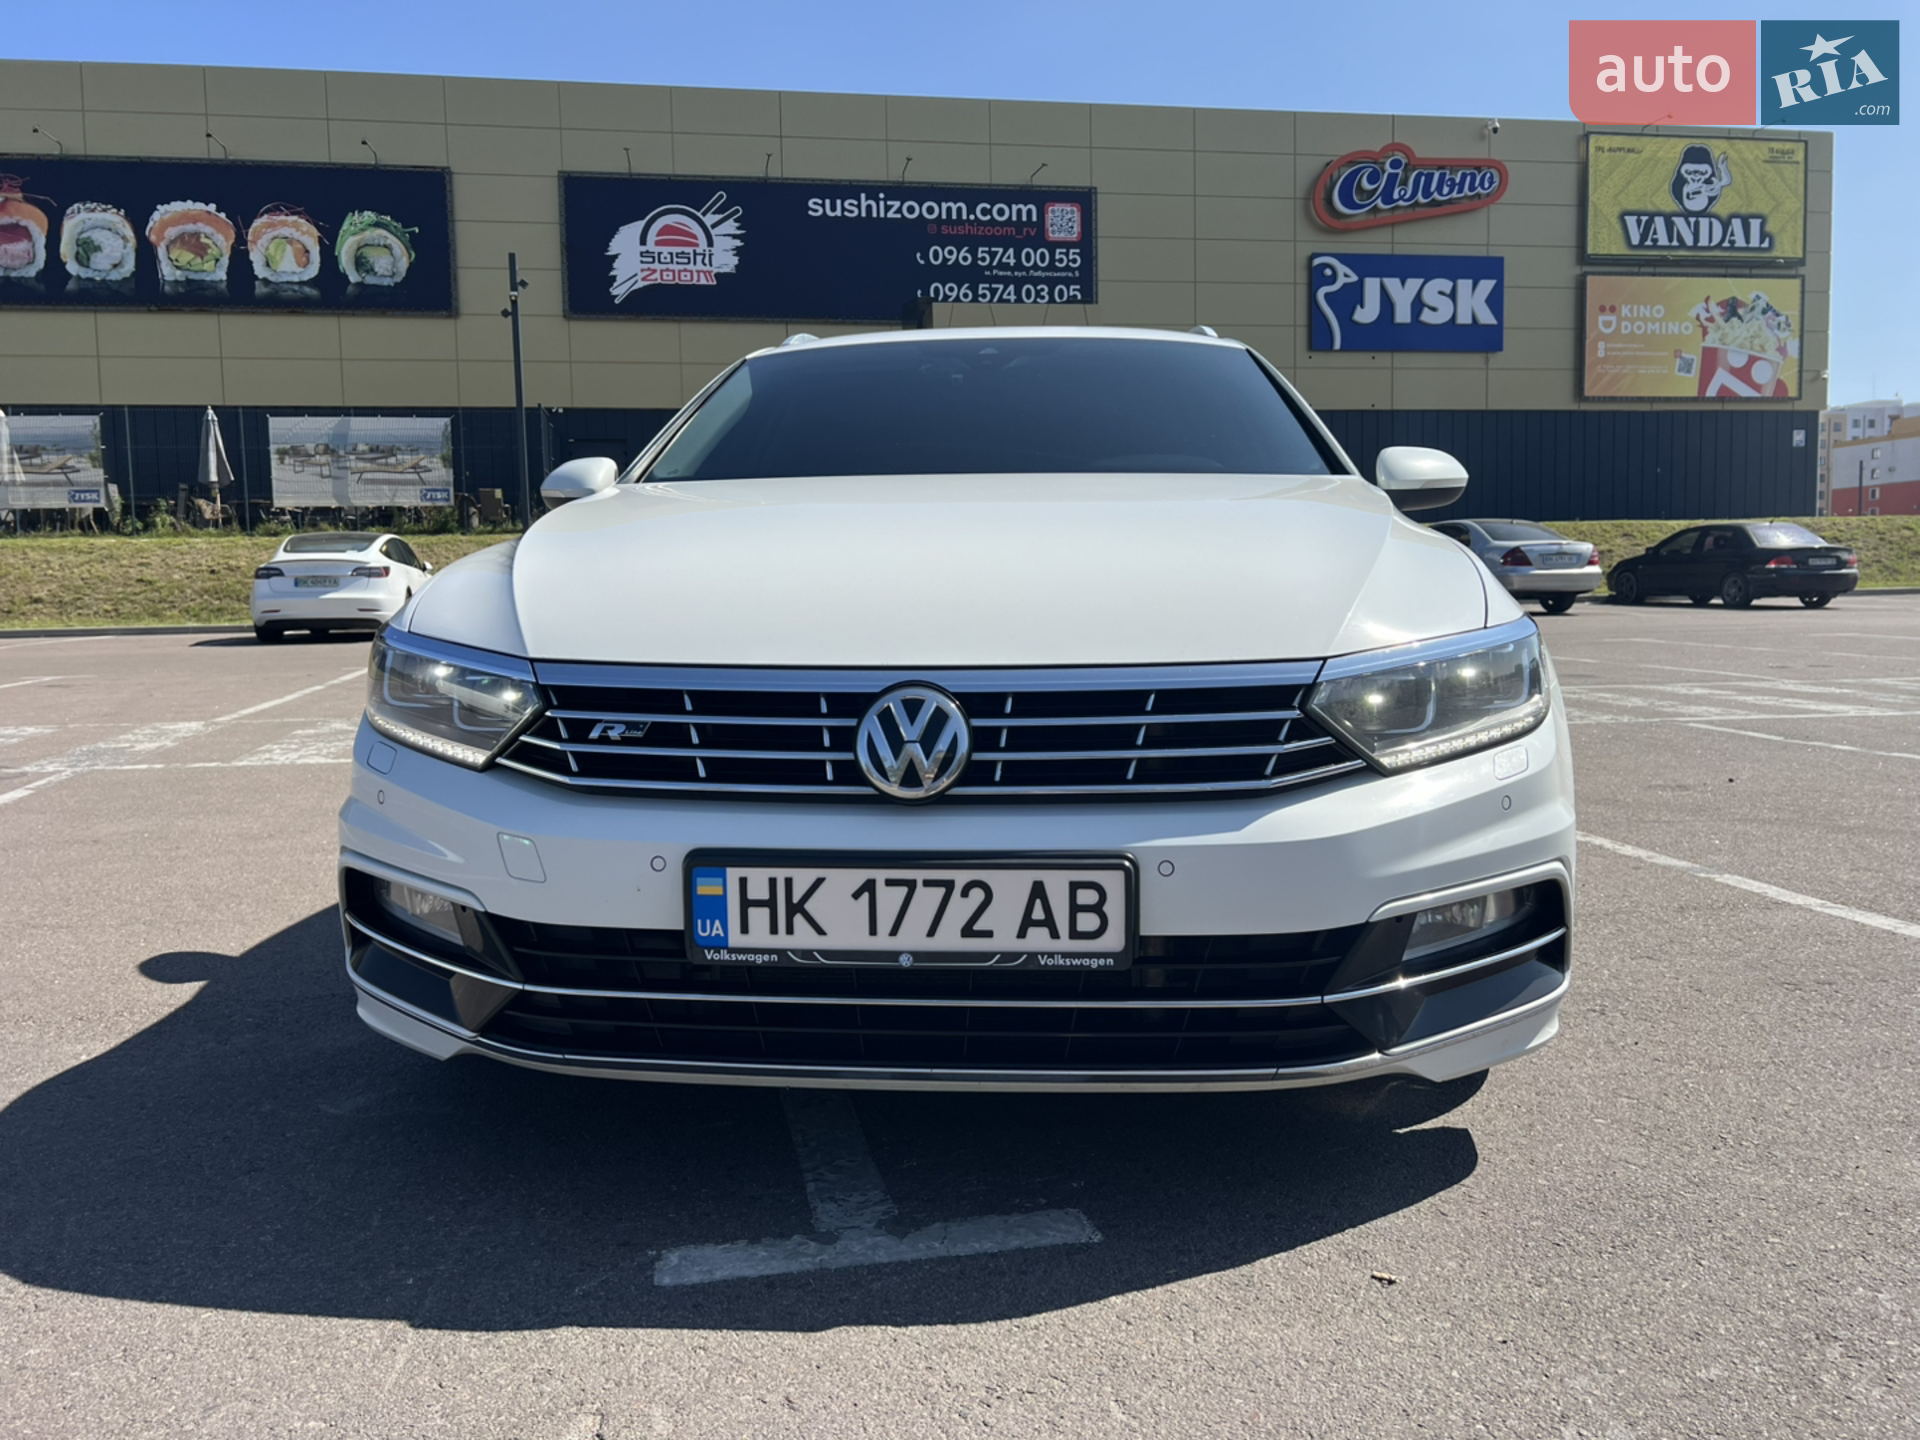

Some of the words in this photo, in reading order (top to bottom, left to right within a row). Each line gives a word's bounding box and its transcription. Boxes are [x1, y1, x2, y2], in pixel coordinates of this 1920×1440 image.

[1332, 156, 1500, 215] Сільпо
[807, 193, 1038, 222] sushizoom.com
[941, 223, 1037, 238] sushizoom_rv
[1623, 215, 1770, 248] VANDAL
[639, 248, 714, 268] sushi
[929, 245, 972, 266] 096
[977, 246, 1016, 267] 574
[1021, 247, 1050, 267] 00
[1055, 248, 1081, 268] 55
[929, 282, 973, 303] 096
[978, 283, 1017, 304] 574
[1021, 284, 1049, 304] 03
[1054, 285, 1082, 304] 05
[1352, 276, 1499, 326] JYSK
[1621, 304, 1665, 319] KINO
[1621, 321, 1694, 335] DOMINO
[75, 492, 98, 500] JYSK
[426, 491, 449, 500] JYSK
[588, 723, 621, 740] R
[738, 876, 828, 936] HK
[851, 877, 994, 939] 1772
[1016, 880, 1109, 940] AB
[697, 919, 725, 937] UA
[704, 949, 778, 964] Volkswagen
[1037, 954, 1114, 968] Volkswagen
